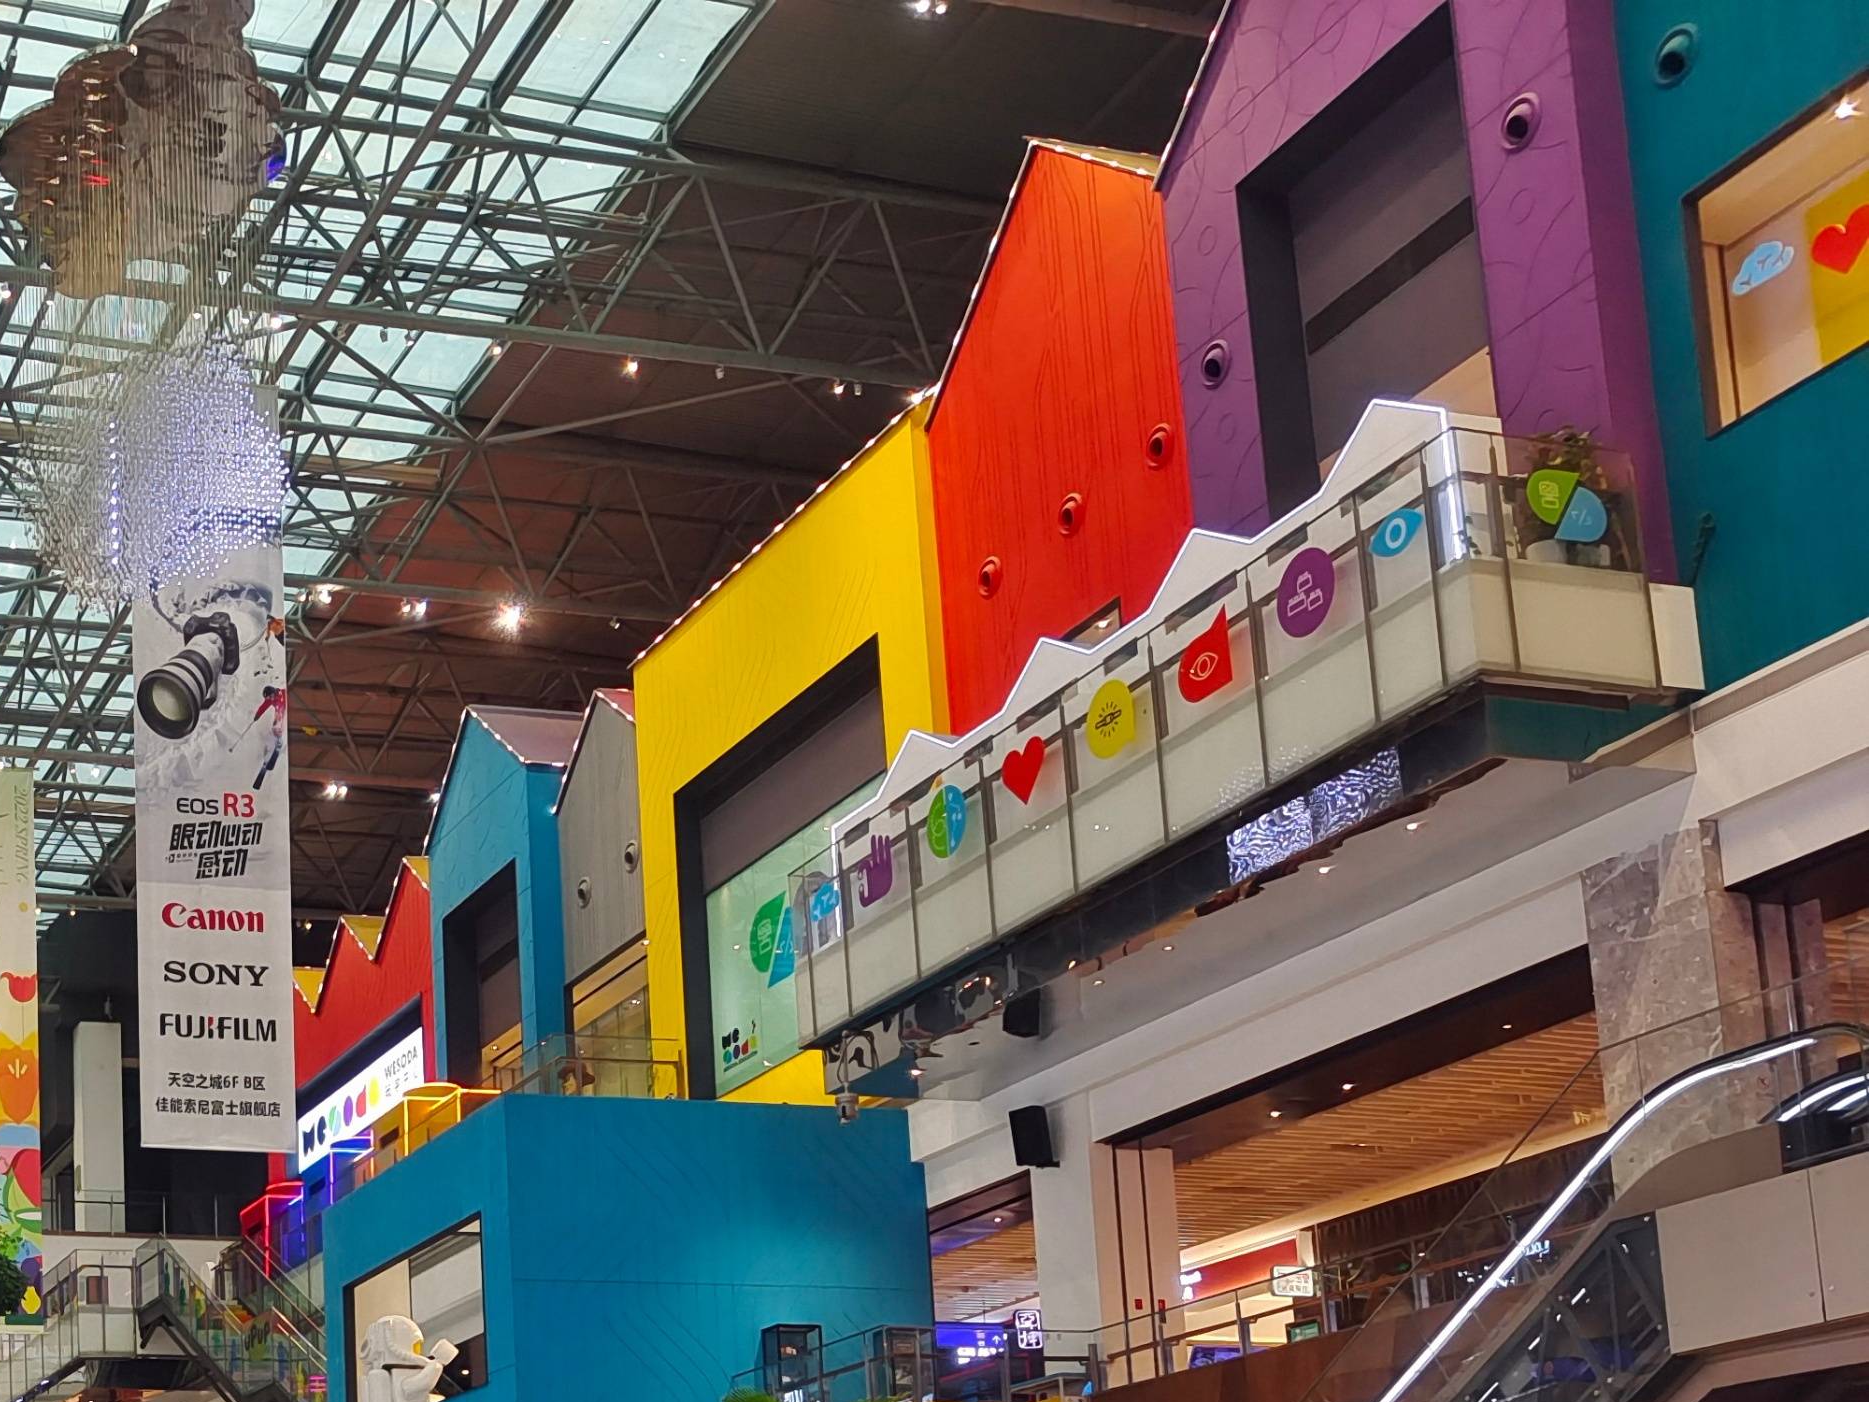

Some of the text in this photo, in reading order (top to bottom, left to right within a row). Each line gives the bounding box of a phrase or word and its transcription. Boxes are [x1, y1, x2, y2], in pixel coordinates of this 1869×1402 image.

[176, 792, 255, 818] EOS R3
[169, 821, 263, 851] 眼动心动
[195, 848, 249, 880] 感动
[161, 902, 264, 933] Canon
[163, 960, 269, 987] SONY
[159, 1013, 277, 1042] FUJIFILM
[167, 1072, 266, 1091] 天空之城6F B区
[155, 1096, 281, 1118] 佳能索尼富士旗舰店
